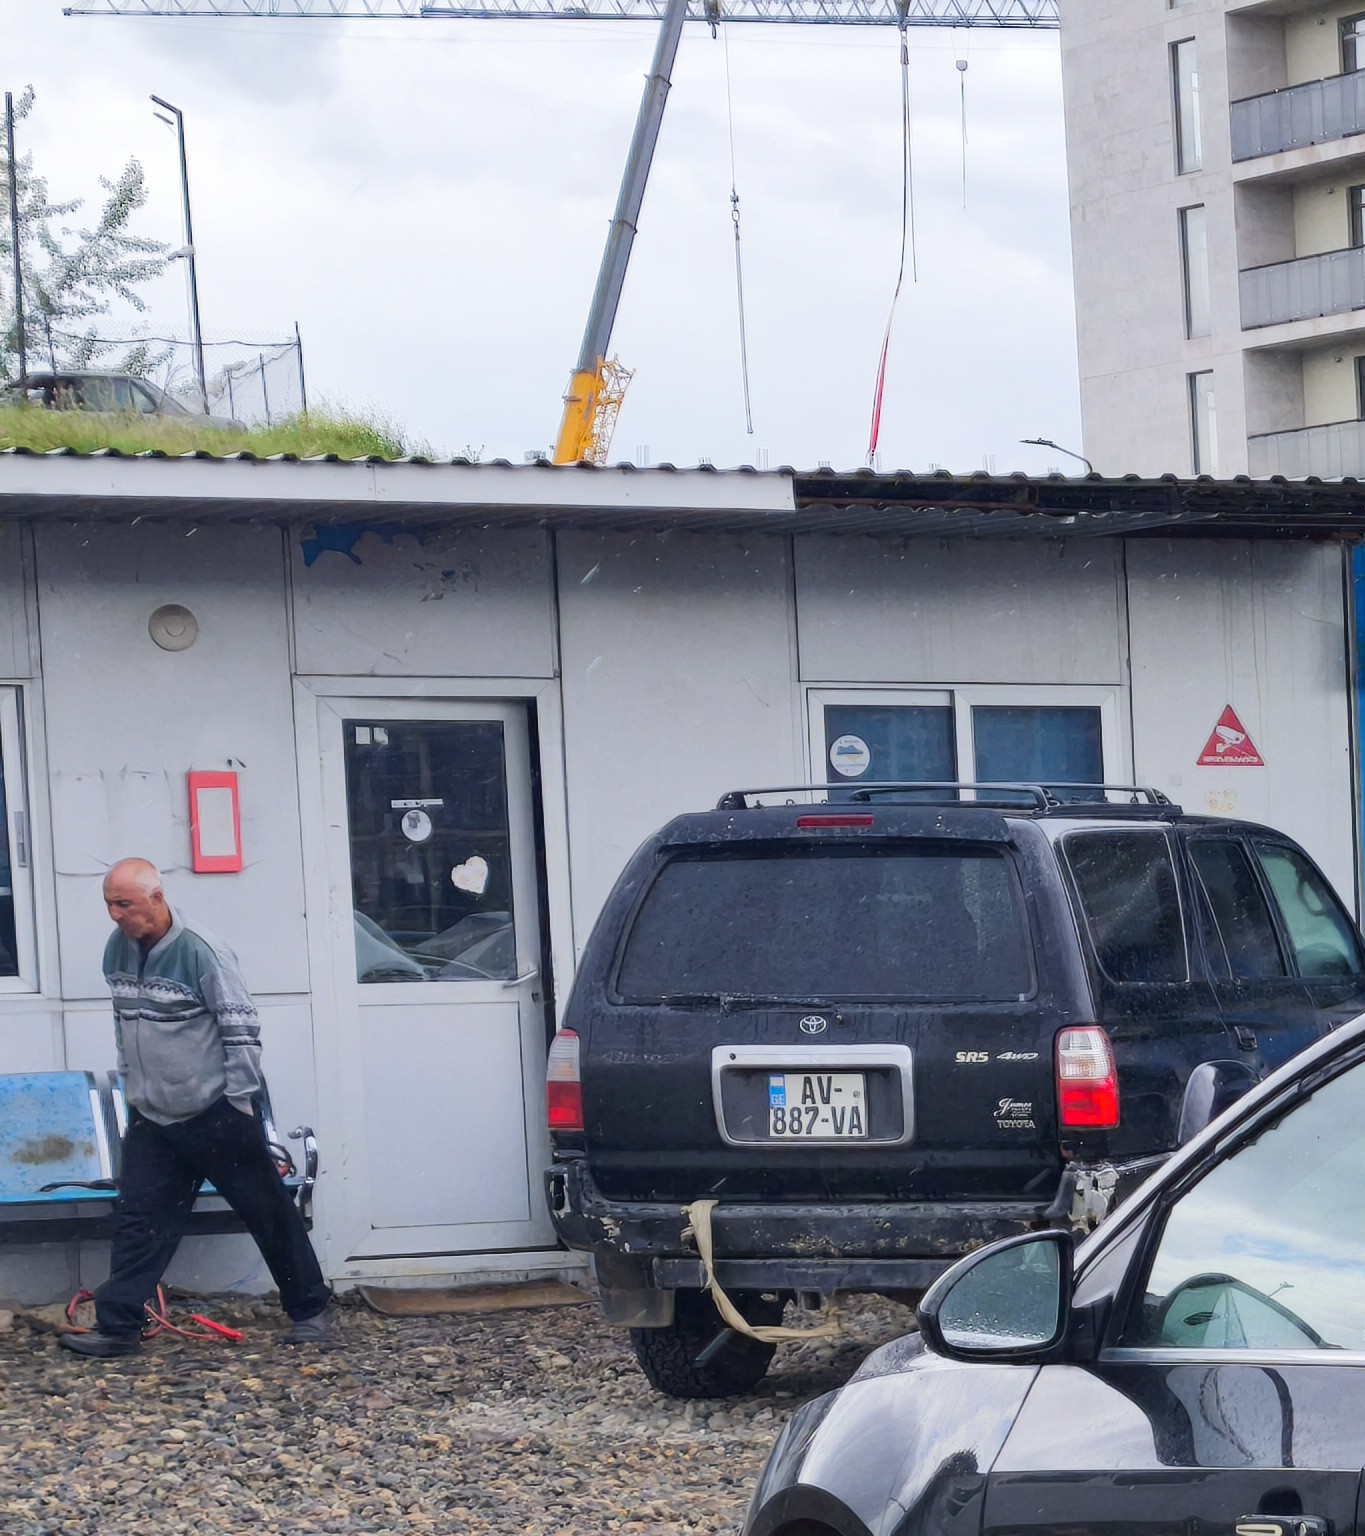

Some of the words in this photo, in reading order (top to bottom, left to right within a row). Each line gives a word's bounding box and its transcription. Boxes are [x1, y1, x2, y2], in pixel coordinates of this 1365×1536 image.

[996, 1051, 1039, 1061] 4WD
[801, 1075, 843, 1105] AV-
[772, 1105, 863, 1135] 887-VA
[996, 1119, 1036, 1129] TOYOTA
